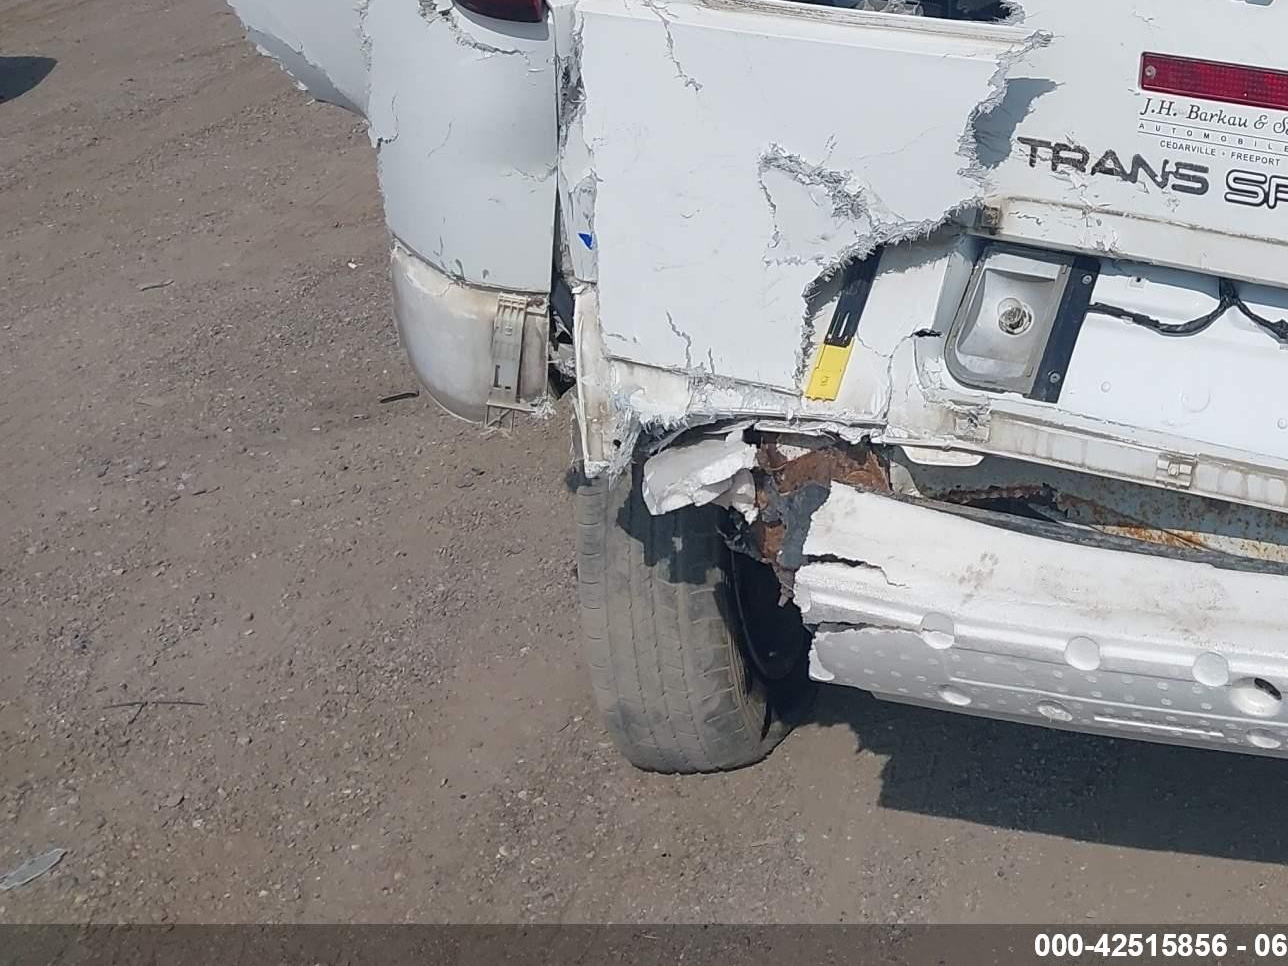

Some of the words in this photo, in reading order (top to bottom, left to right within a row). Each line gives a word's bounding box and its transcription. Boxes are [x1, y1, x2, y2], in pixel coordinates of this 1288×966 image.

[1140, 97, 1178, 117] J.H.
[1186, 104, 1249, 129] Barkau
[1253, 114, 1268, 130] &
[1017, 136, 1210, 196] TRANS
[1159, 140, 1217, 157] CEDARVILLE
[1230, 151, 1281, 167] FREEPORT
